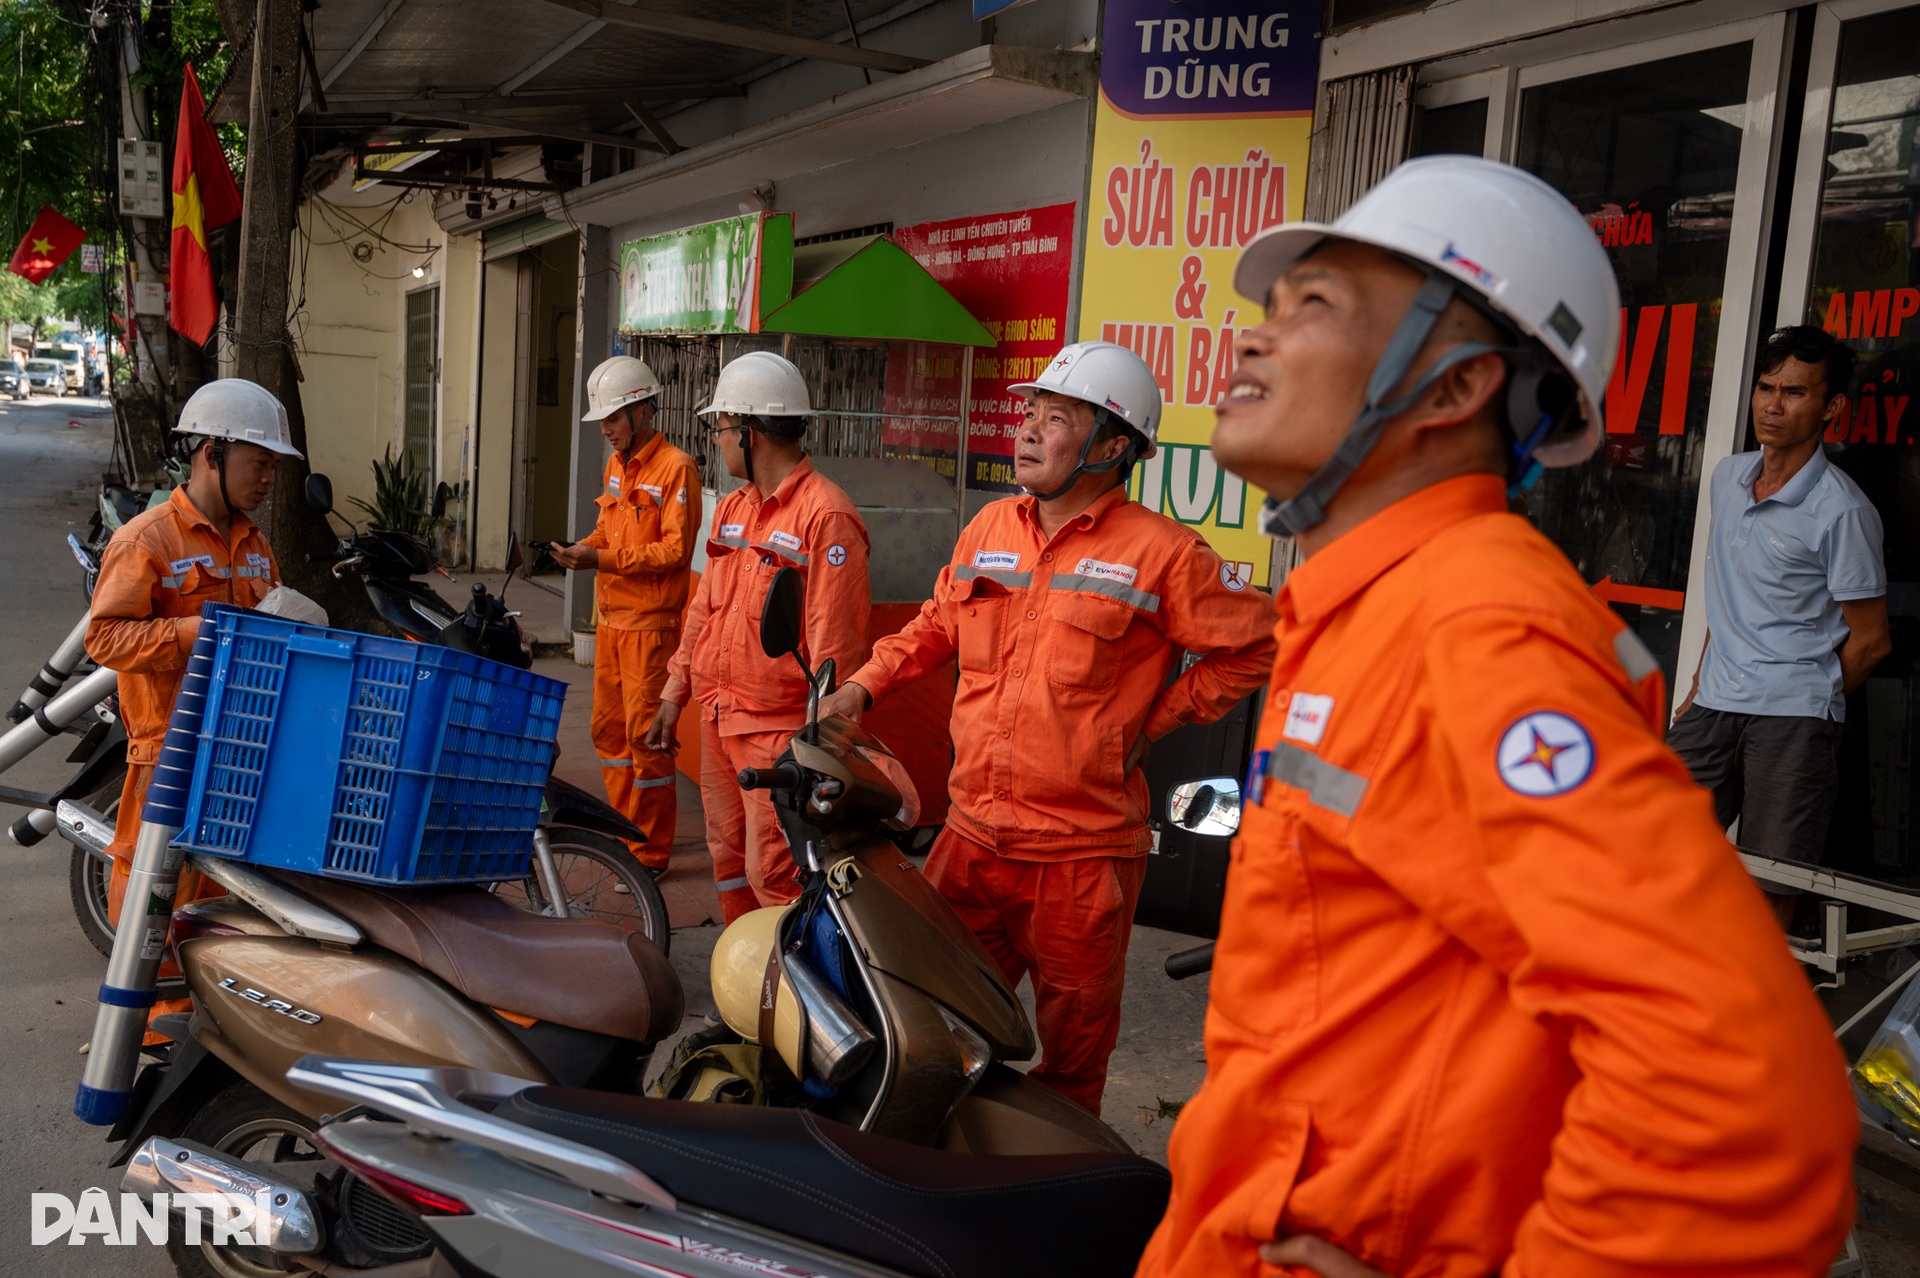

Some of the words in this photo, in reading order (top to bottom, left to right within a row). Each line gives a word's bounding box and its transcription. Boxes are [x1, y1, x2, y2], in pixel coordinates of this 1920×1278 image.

[1135, 13, 1289, 53] TRUNG
[1144, 58, 1271, 99] DŨNG
[1103, 138, 1174, 247] SỬA
[1186, 149, 1285, 248] CHỮA
[942, 229, 951, 243] XE
[951, 227, 966, 242] LINH
[967, 221, 980, 239] YẾN
[981, 218, 1007, 237] CHUYÊN
[1009, 213, 1032, 233] TUYẾN
[1012, 242, 1021, 256] TP
[1022, 237, 1037, 255] THÁI
[1039, 235, 1058, 252] BÌNH
[1174, 255, 1208, 320] &
[1005, 319, 1028, 341] 6H00
[1030, 313, 1056, 341] SÁNG
[1821, 287, 1920, 340] AMP
[1003, 357, 1031, 380] 12H10
[1185, 309, 1252, 406] BÁ
[980, 398, 998, 417] VỰC
[999, 396, 1012, 414] HÀ
[970, 419, 997, 437] ĐÔNG
[976, 461, 990, 481] ĐT:
[217, 977, 323, 1026] LEAD
[762, 979, 773, 1010] Vespa
